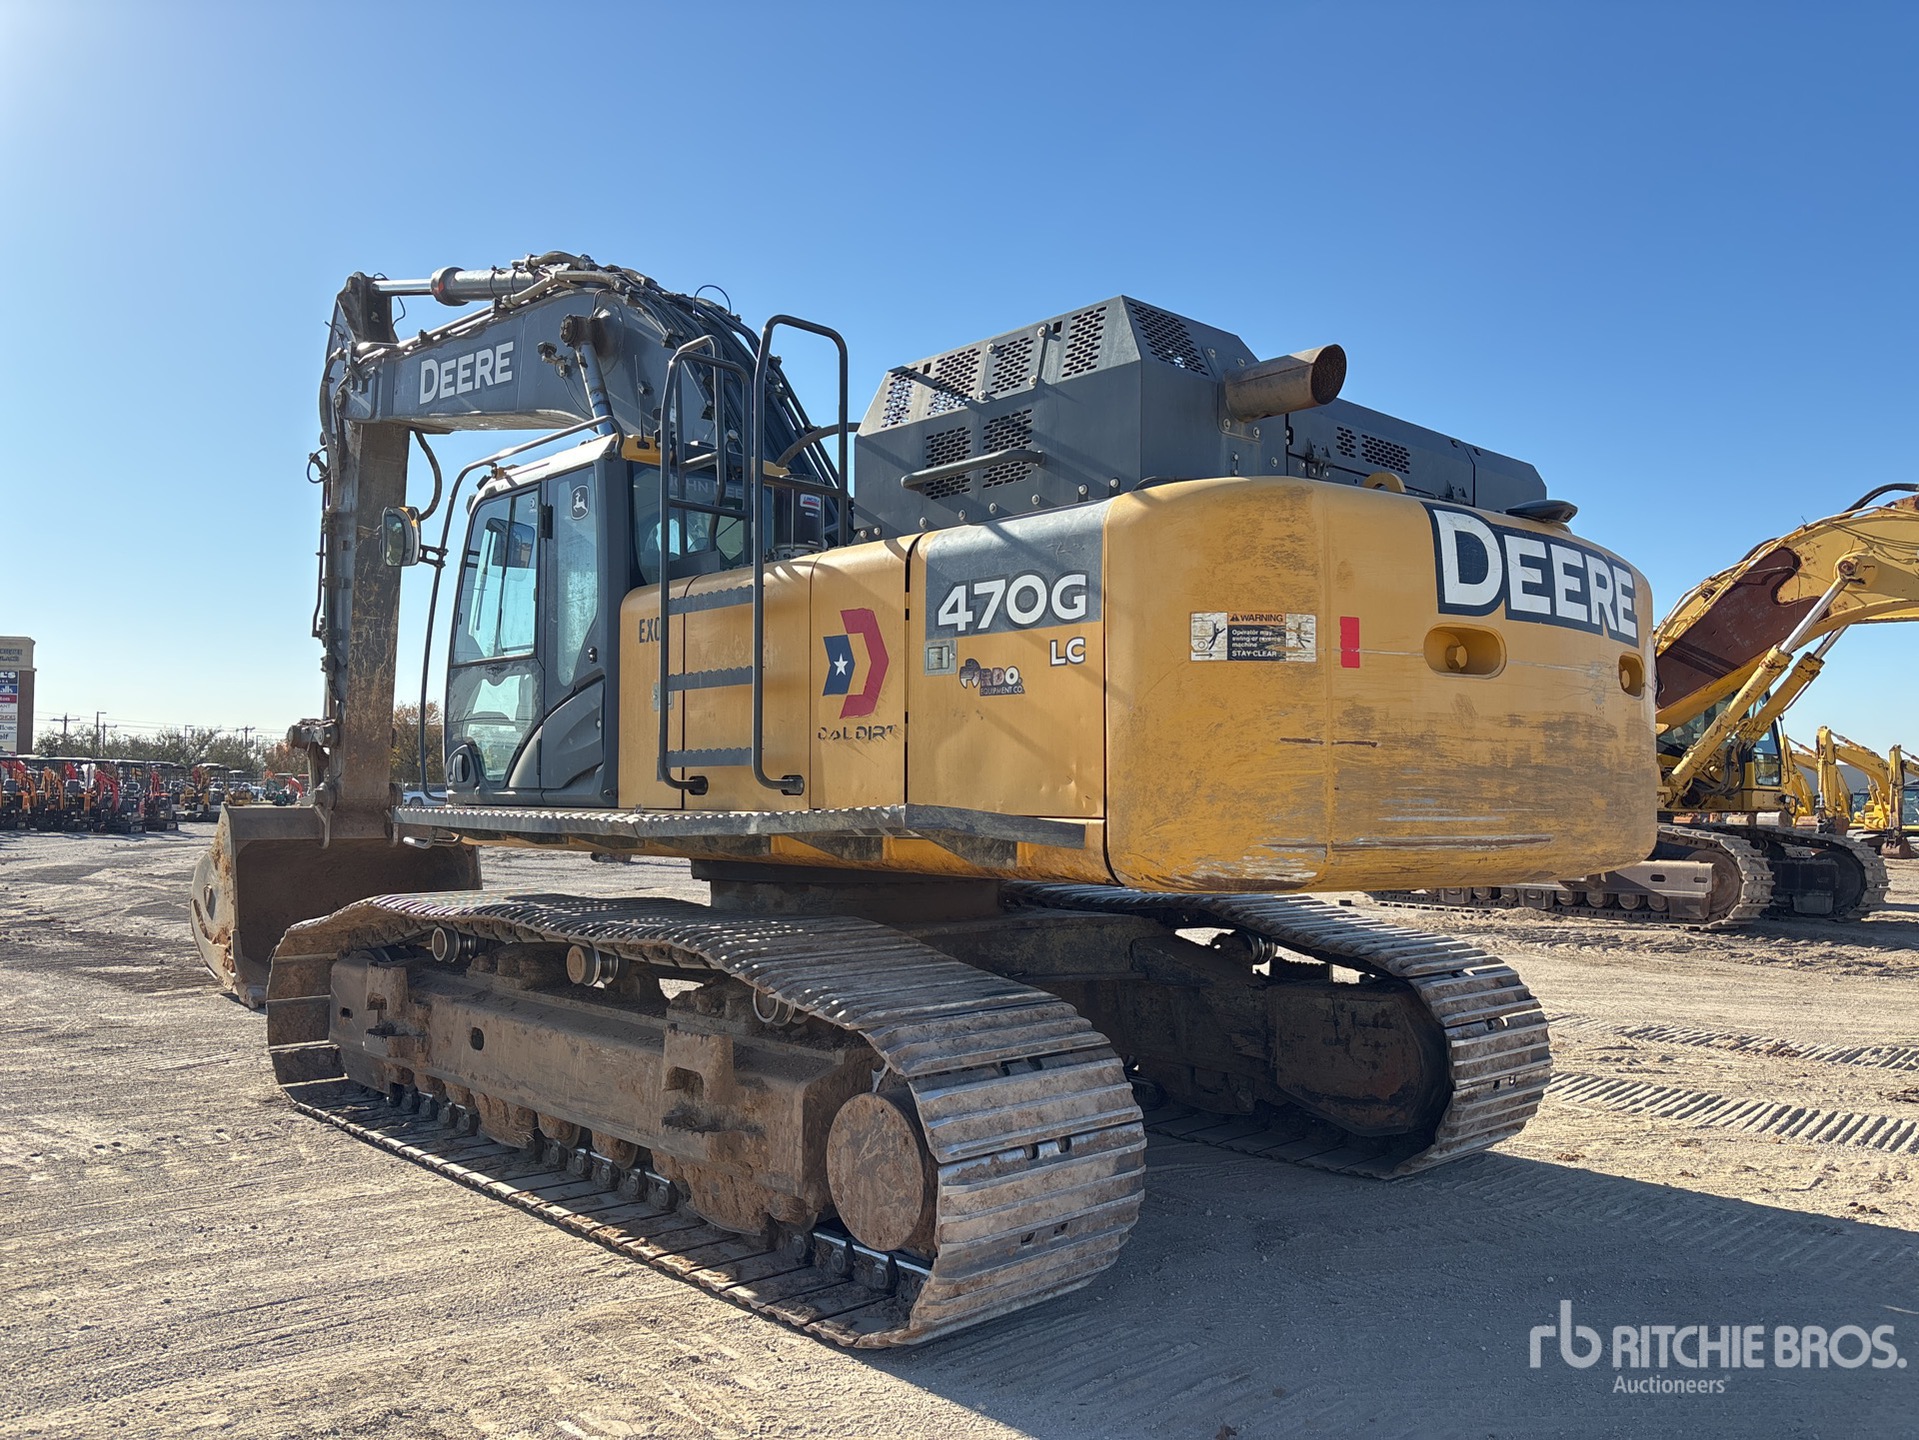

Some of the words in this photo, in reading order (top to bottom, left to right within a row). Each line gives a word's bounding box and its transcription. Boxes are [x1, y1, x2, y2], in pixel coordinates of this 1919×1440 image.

[419, 341, 514, 405] DEERE
[938, 574, 1087, 631] 470G
[1432, 509, 1637, 639] DEERE
[1240, 613, 1283, 622] WARNING
[1050, 637, 1085, 666] LC
